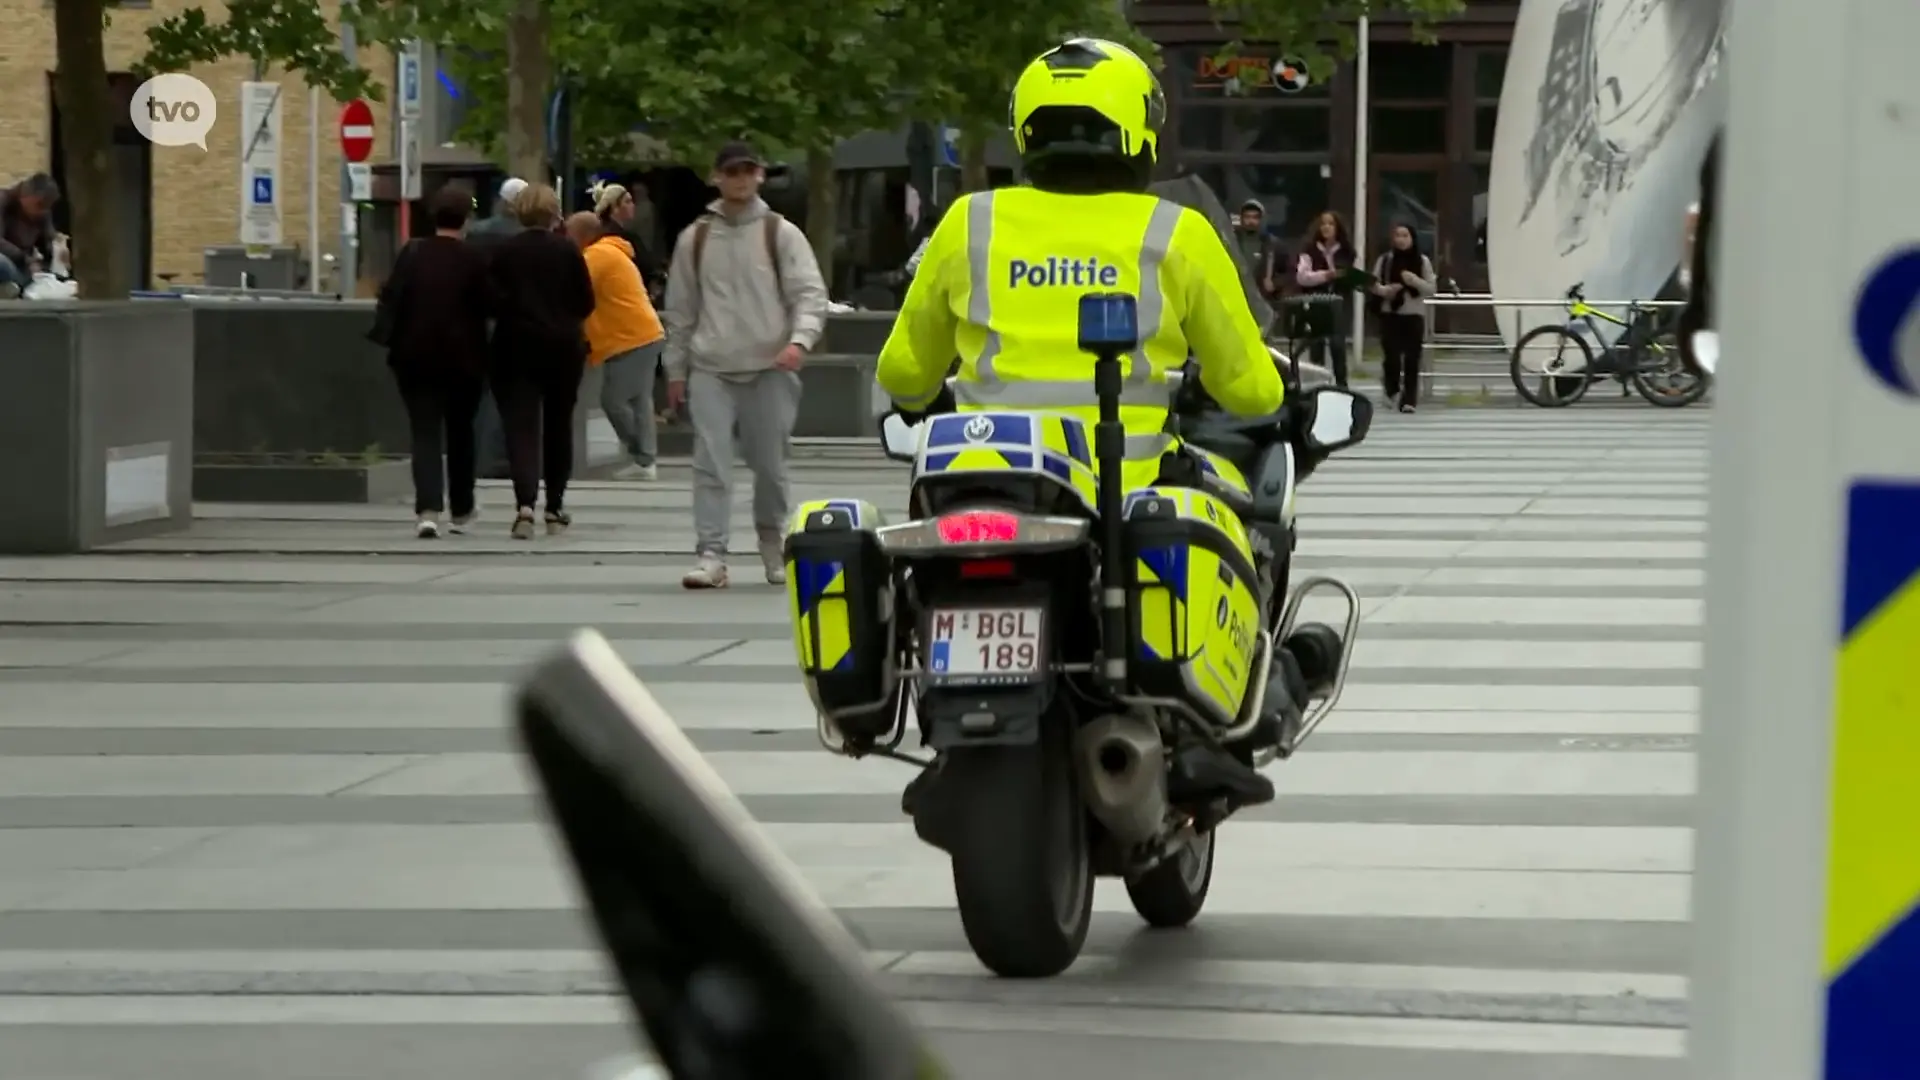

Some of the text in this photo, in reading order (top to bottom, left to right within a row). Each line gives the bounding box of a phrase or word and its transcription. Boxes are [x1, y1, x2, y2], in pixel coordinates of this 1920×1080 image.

[1009, 256, 1118, 289] Politie
[936, 611, 1036, 640] M BGL
[978, 642, 1035, 670] 189
